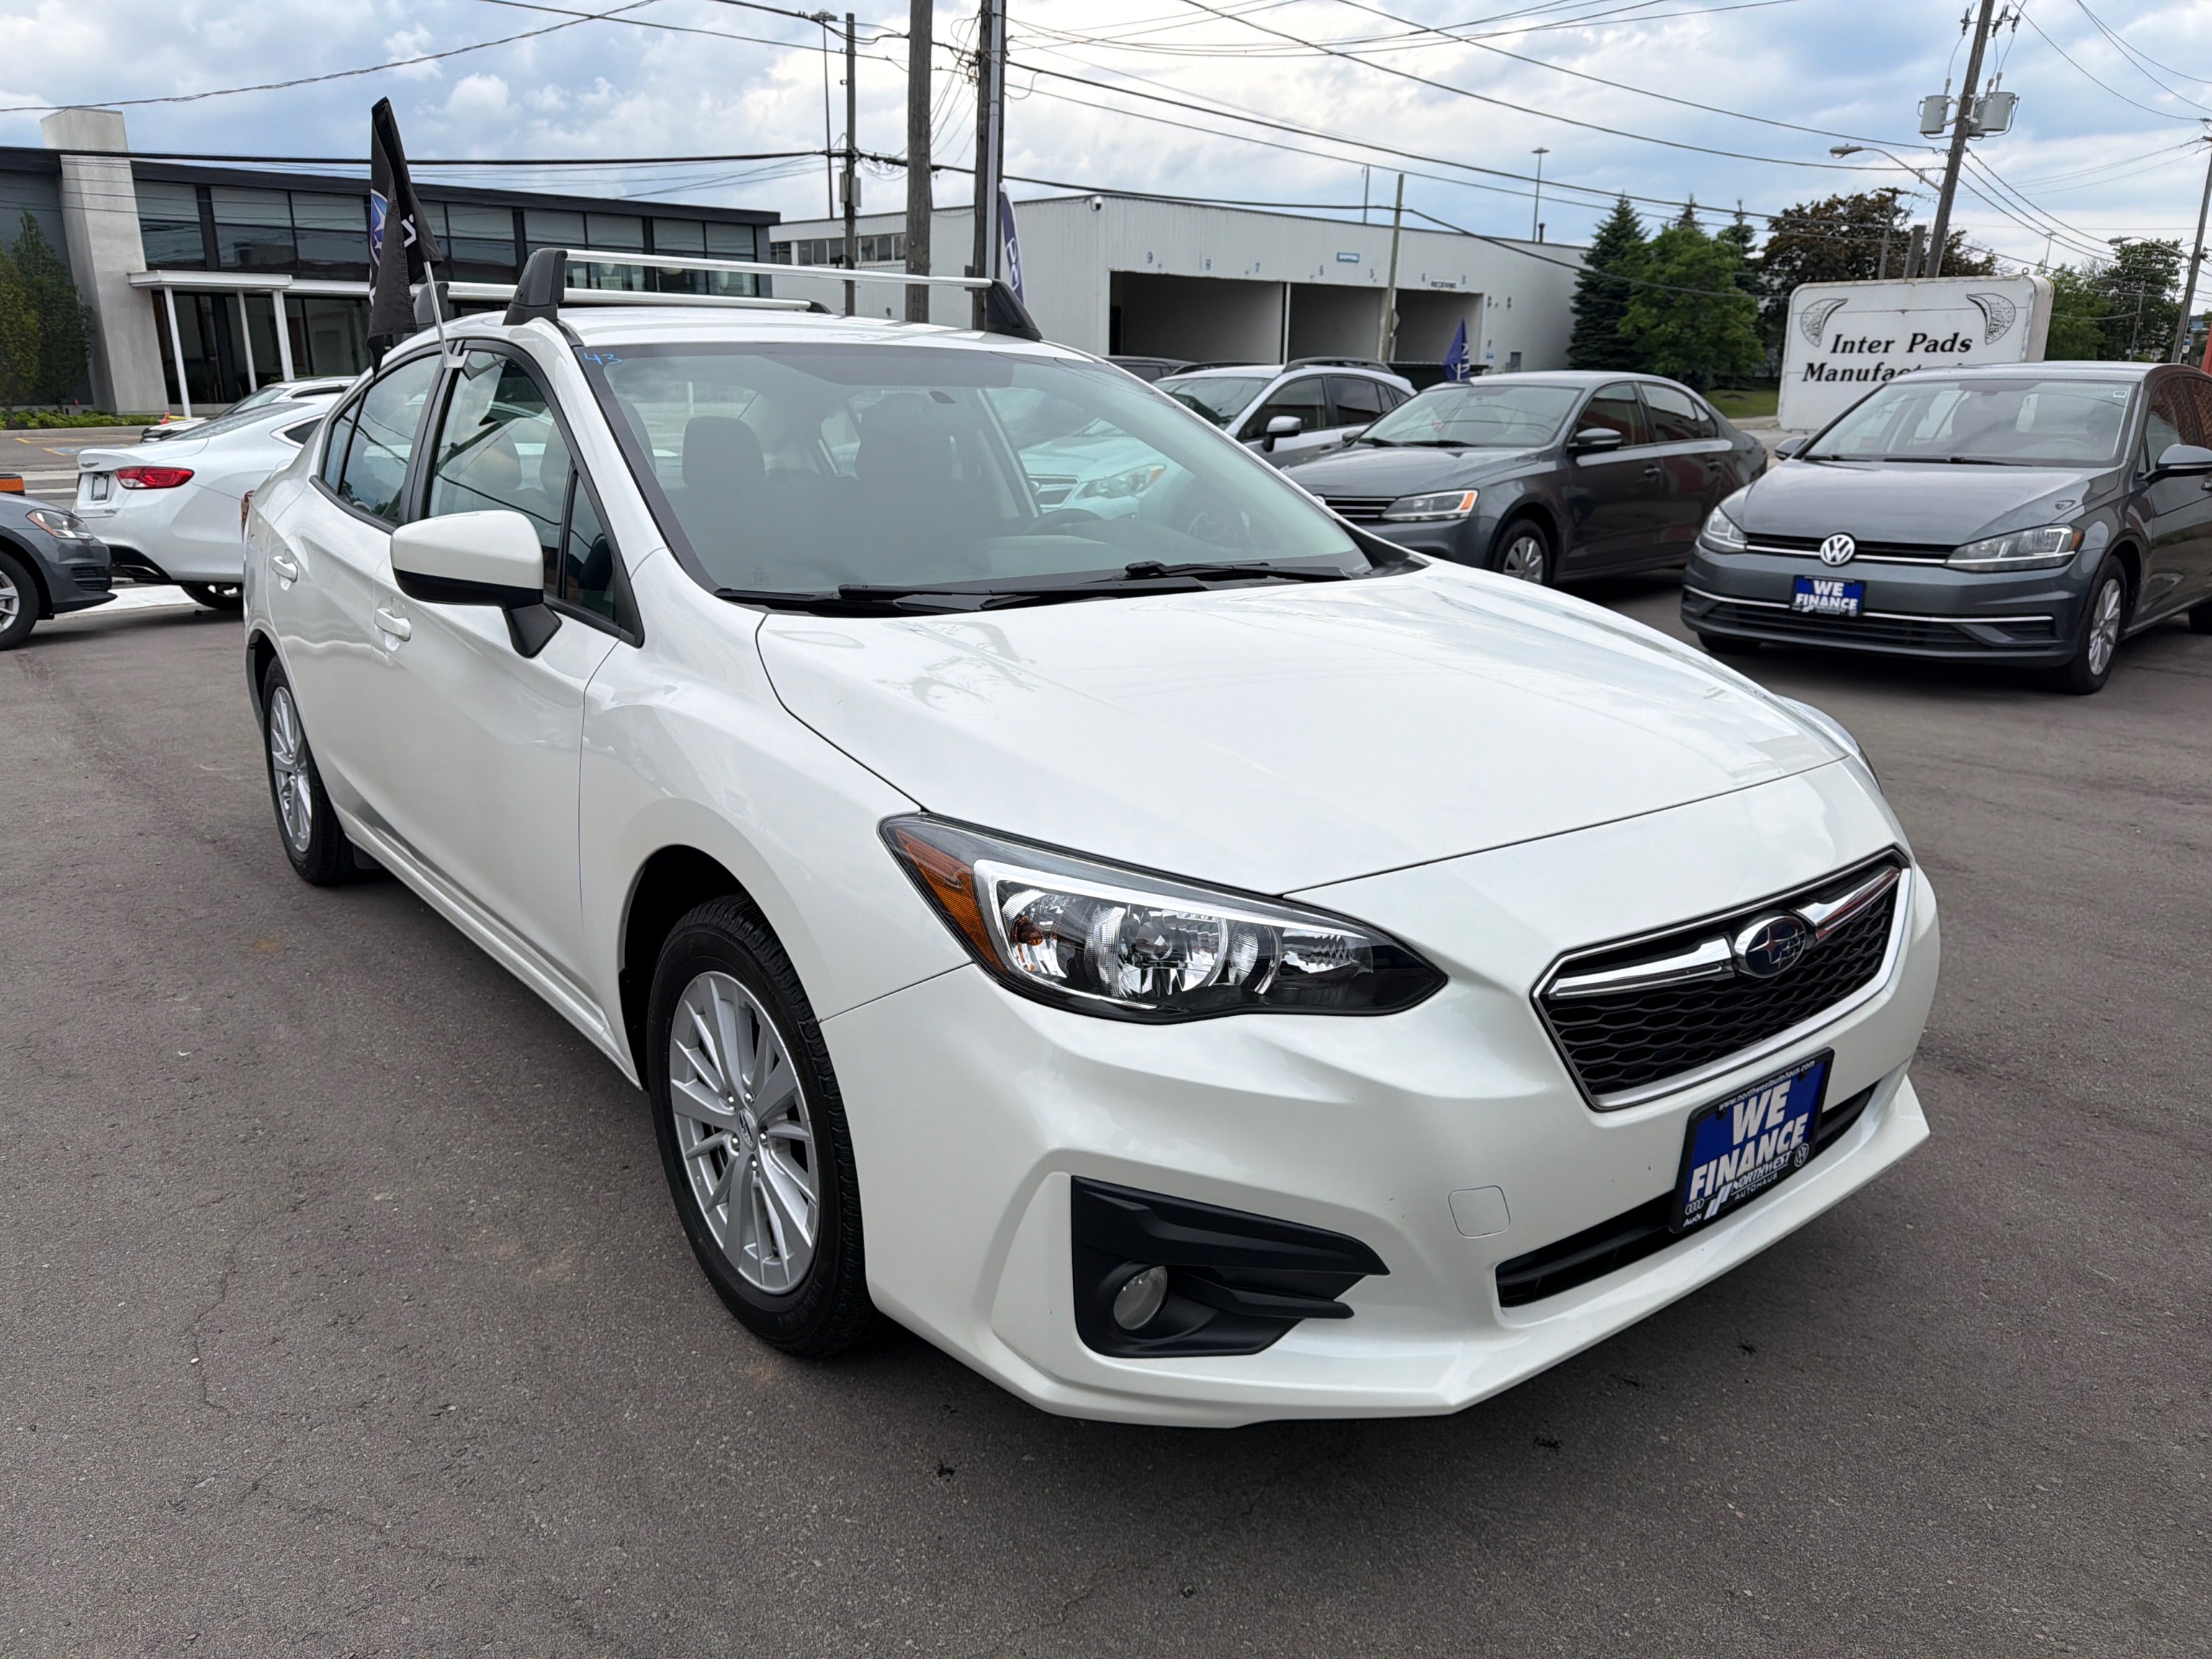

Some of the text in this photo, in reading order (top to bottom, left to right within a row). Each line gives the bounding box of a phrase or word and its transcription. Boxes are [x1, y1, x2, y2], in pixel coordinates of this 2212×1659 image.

[1830, 332, 1973, 354] Inter Pads
[583, 352, 623, 365] 43
[1802, 361, 1922, 382] Manufa
[1813, 580, 1845, 597] WE
[1795, 593, 1858, 611] FINANCE
[1732, 1079, 1792, 1146] WE
[1689, 1112, 1809, 1202] FINANCE
[1730, 1150, 1792, 1192] NORTHWEST
[1734, 1172, 1779, 1201] AUTOHAUS
[1683, 1213, 1702, 1228] Audi
